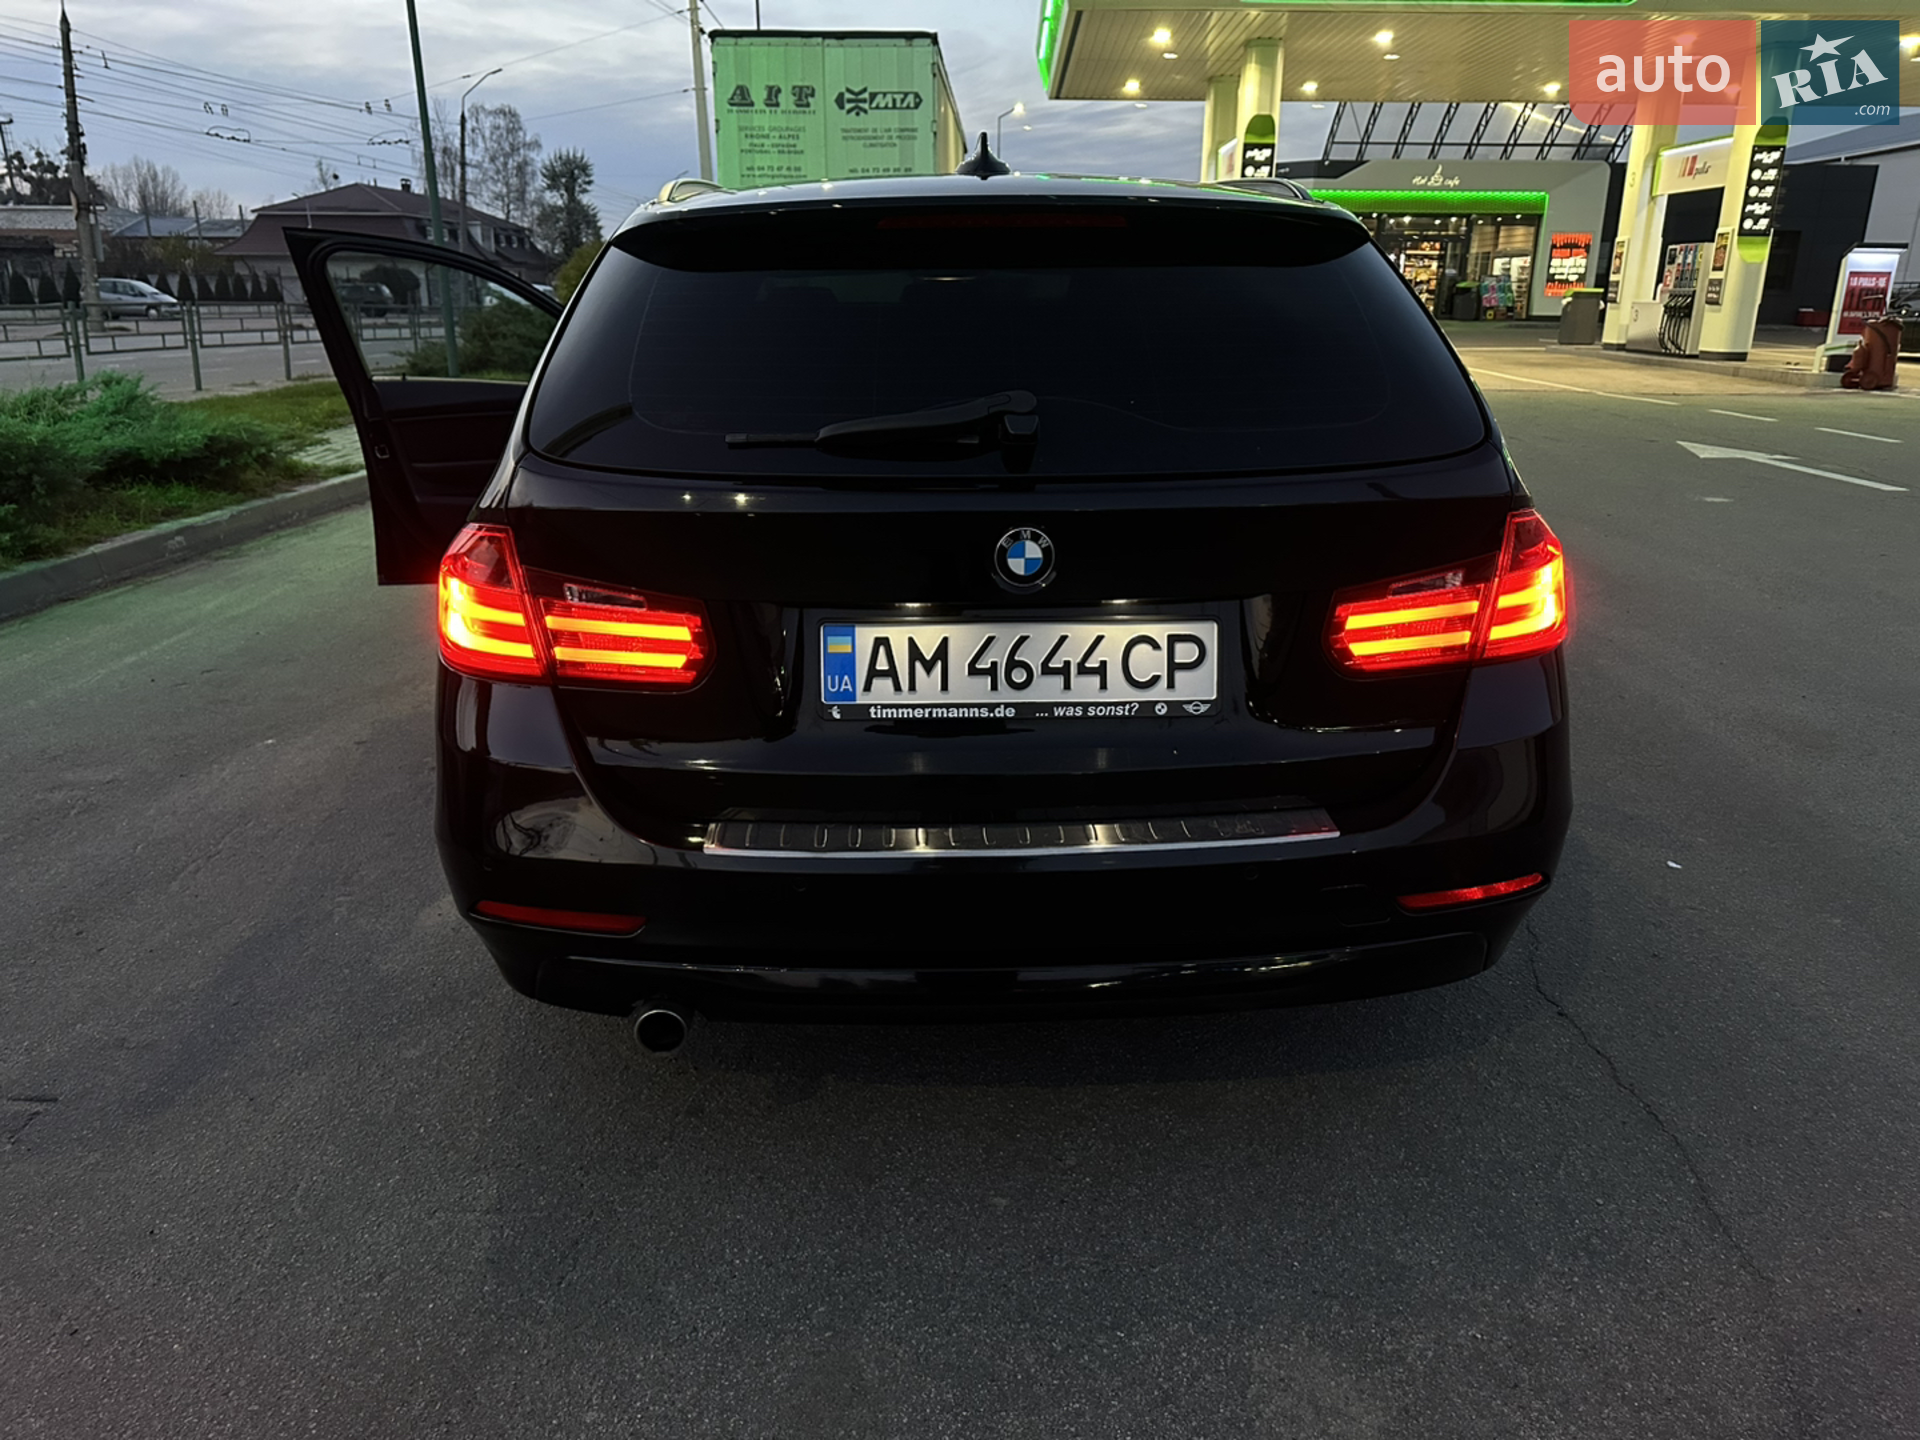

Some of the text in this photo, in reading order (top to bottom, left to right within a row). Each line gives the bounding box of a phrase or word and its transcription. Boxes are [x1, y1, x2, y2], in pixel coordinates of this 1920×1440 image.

[727, 84, 816, 108] AIT
[869, 92, 916, 109] MTA
[861, 633, 1207, 693] AM 4644 CP
[827, 674, 853, 693] UA
[868, 704, 1017, 719] timmermanns.de
[1053, 706, 1084, 717] was
[1087, 702, 1140, 717] sonst?
